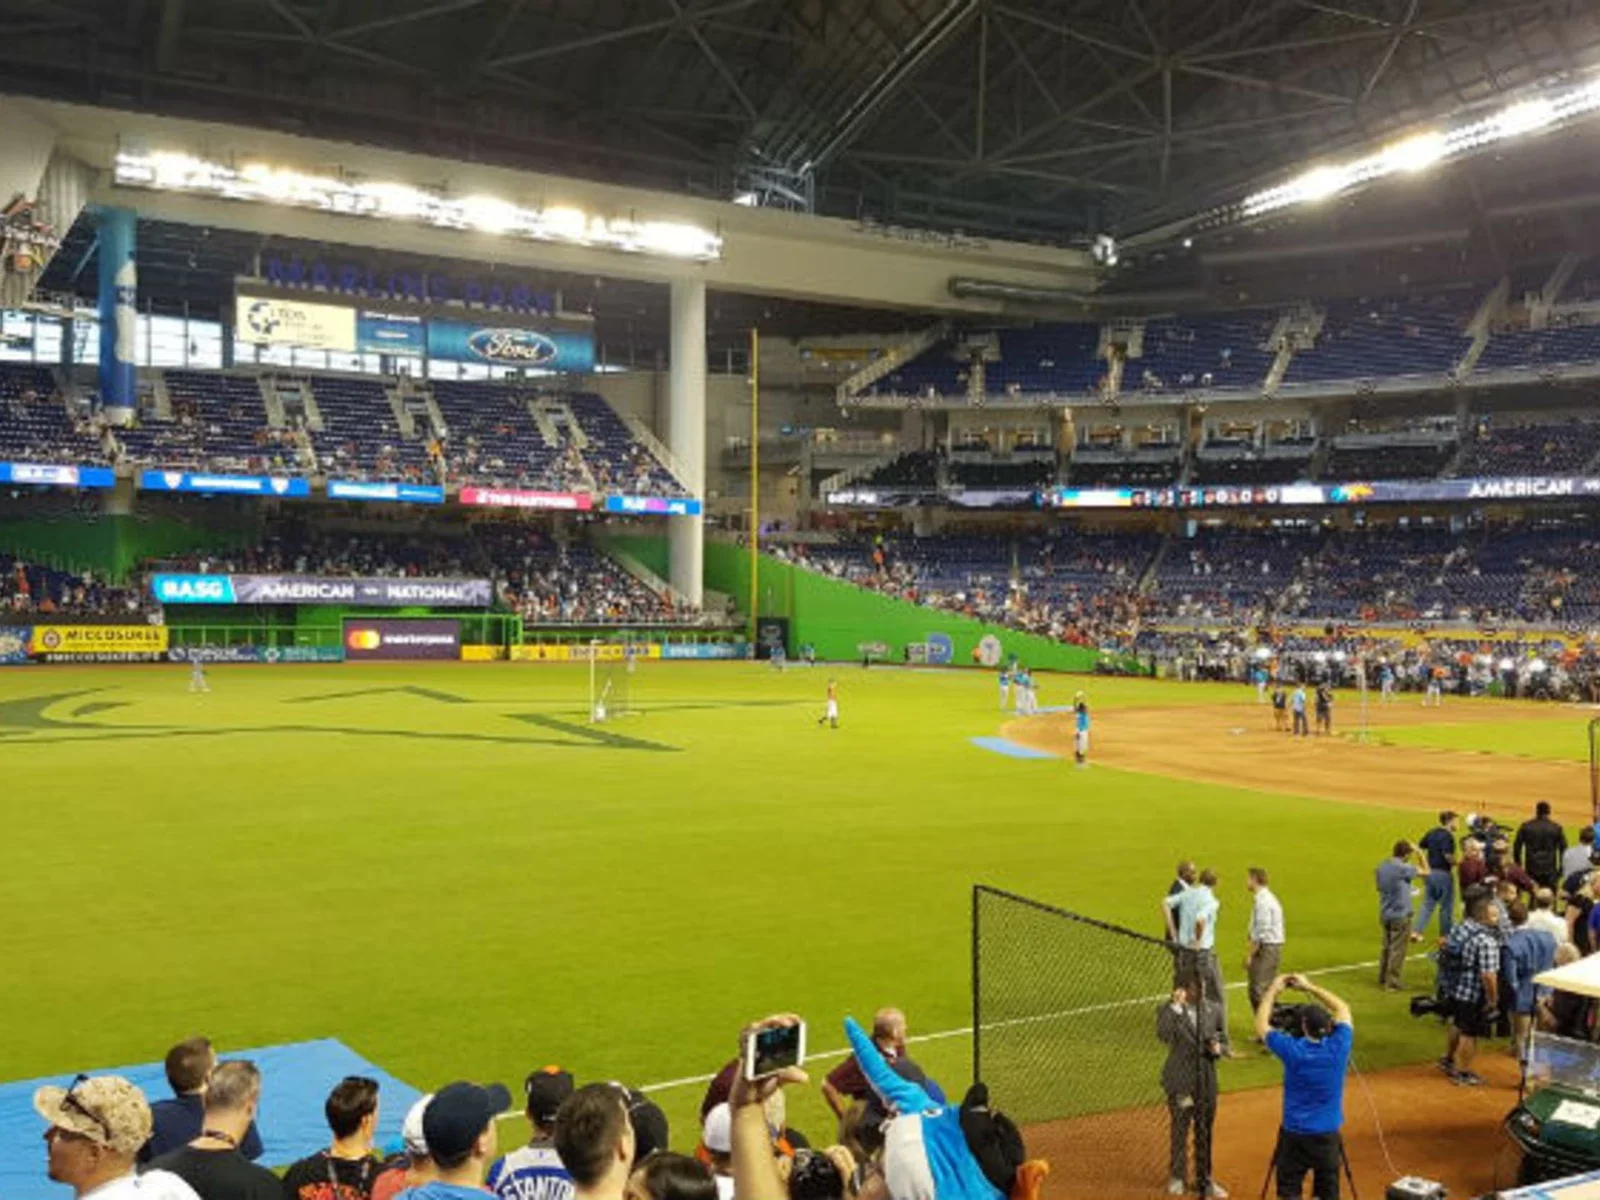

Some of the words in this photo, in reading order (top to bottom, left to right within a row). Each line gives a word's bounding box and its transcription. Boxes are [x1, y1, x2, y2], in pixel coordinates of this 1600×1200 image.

[485, 334, 540, 358] Ford
[1468, 477, 1572, 498] AMERICAN
[260, 583, 355, 599] AMERICAN
[387, 584, 463, 599] NATIONAL
